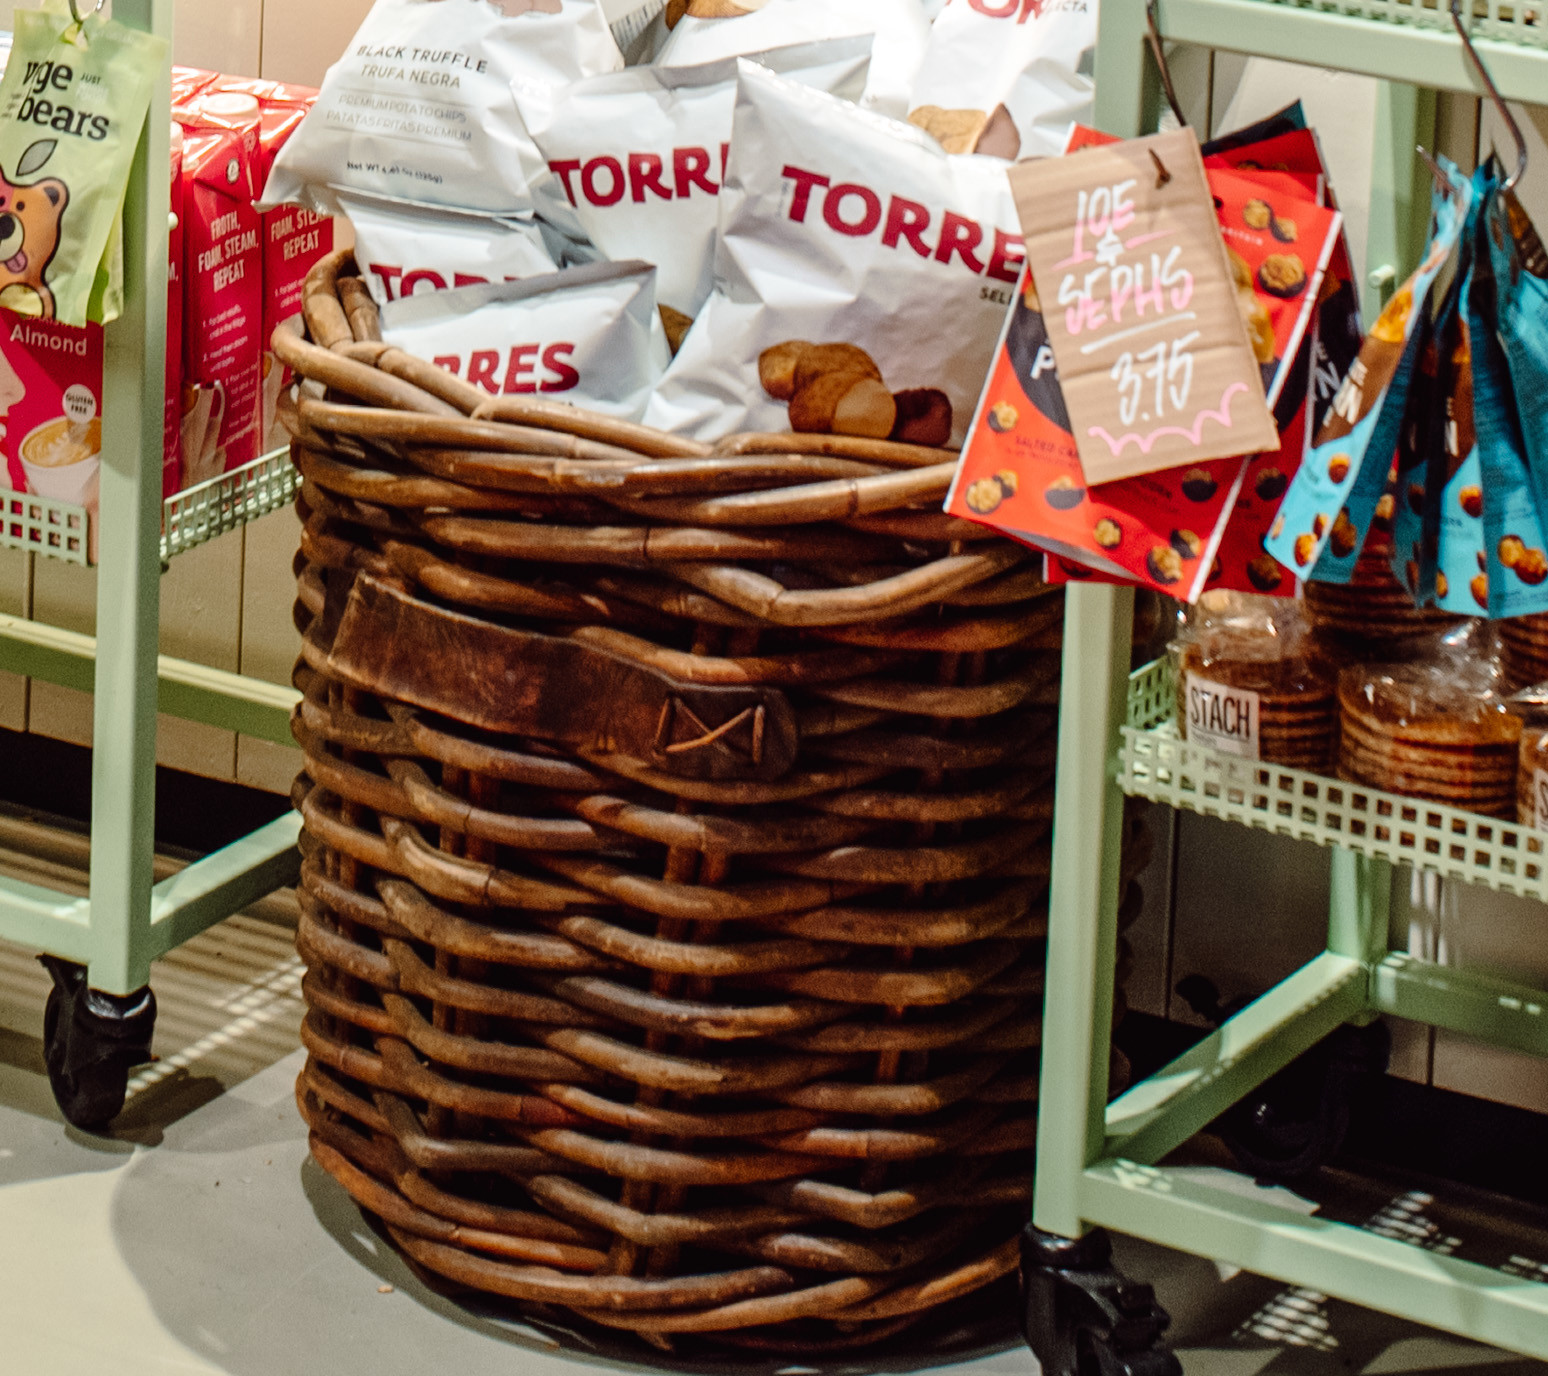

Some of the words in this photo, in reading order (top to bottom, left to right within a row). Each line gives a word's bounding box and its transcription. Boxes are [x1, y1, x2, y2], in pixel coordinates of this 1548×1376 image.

[357, 44, 403, 64] BLACK
[410, 49, 488, 74] TRUFFLE
[17, 95, 109, 140] bears
[1057, 246, 1195, 335] SEPHS
[1110, 332, 1201, 425] 3.75
[1190, 691, 1251, 739] STACH
